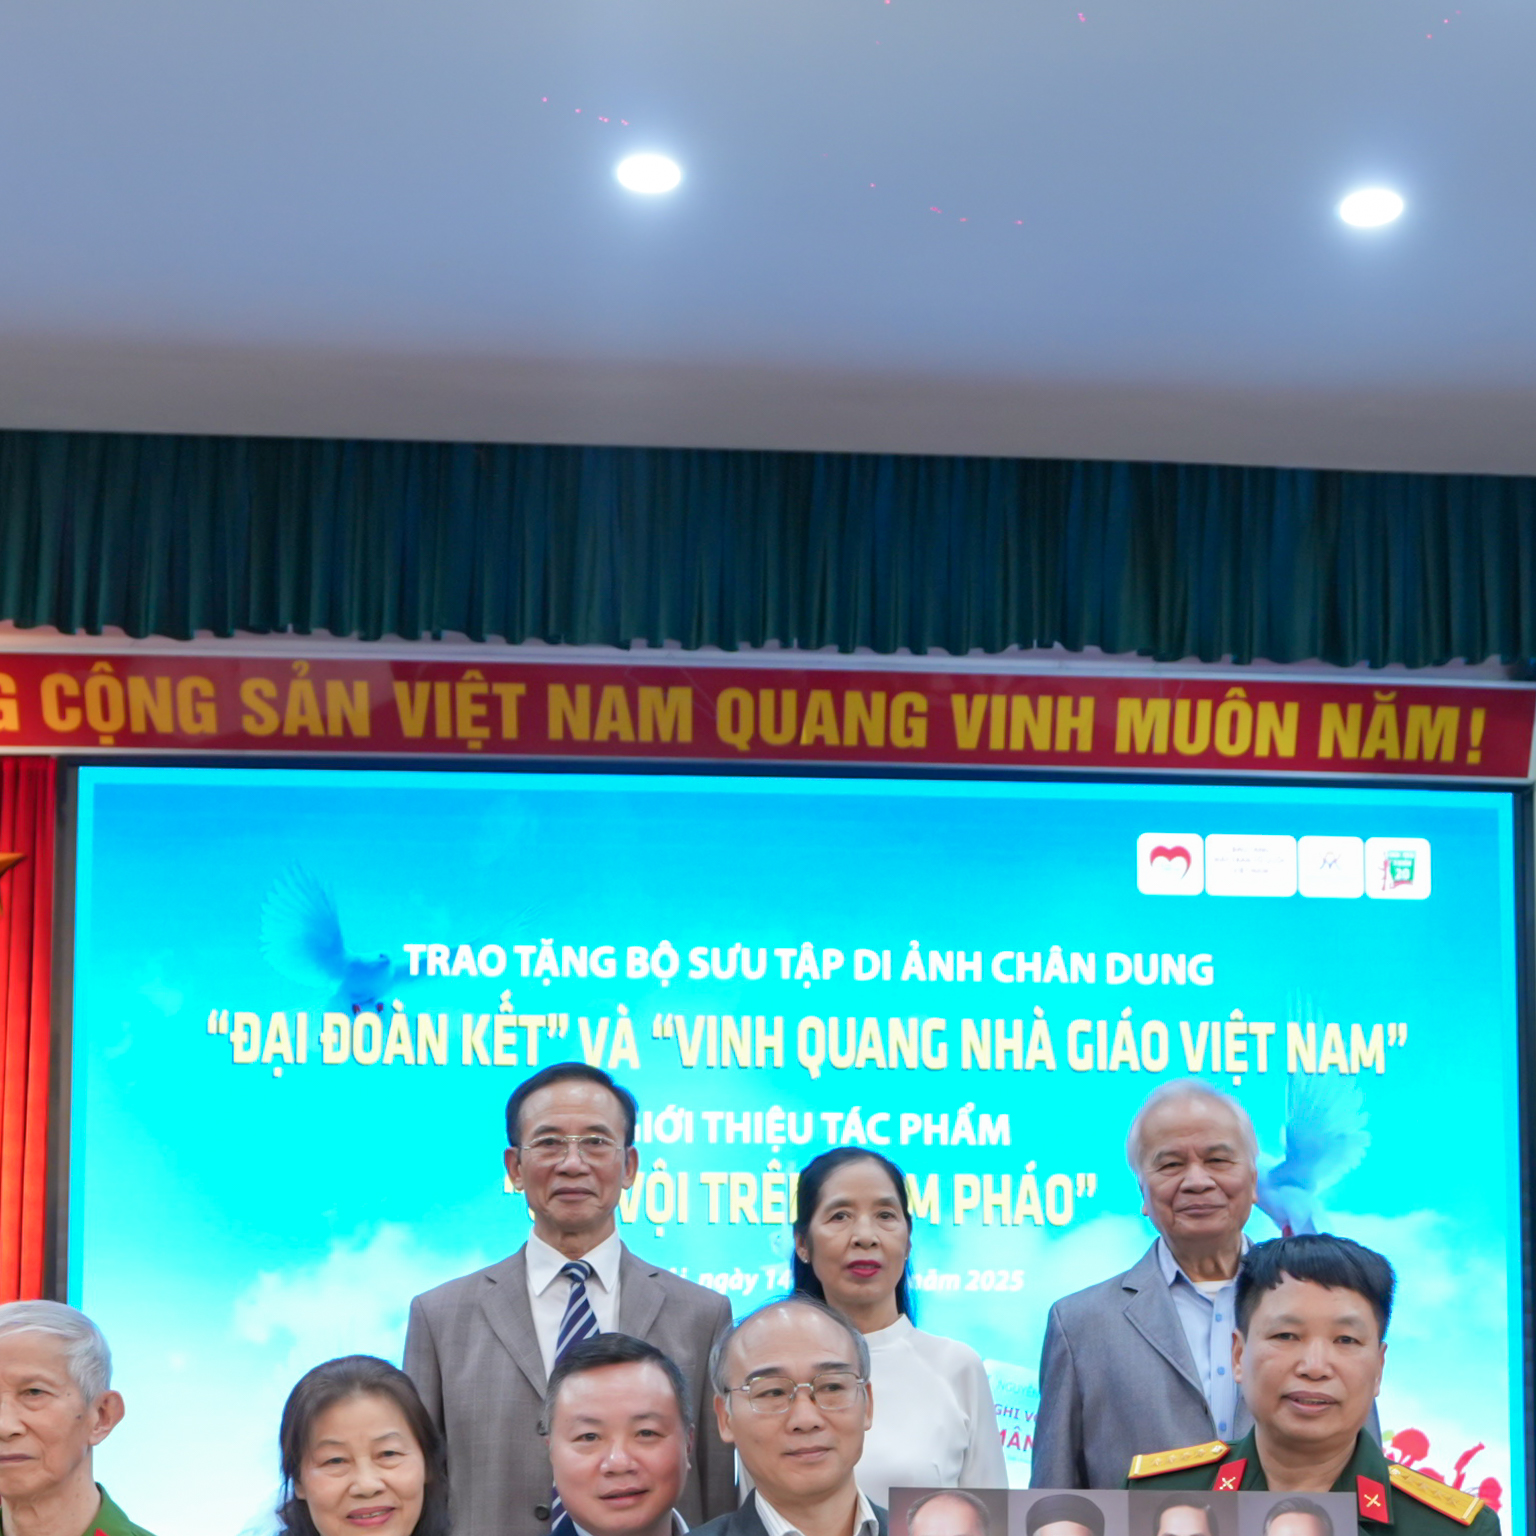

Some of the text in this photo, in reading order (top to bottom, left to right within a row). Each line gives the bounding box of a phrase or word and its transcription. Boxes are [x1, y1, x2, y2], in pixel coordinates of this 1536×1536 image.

[41, 661, 217, 746] CỘNG
[240, 659, 373, 738] SẢN
[393, 669, 527, 751] VIỆT
[547, 683, 694, 744] NAM
[715, 686, 929, 752] QUANG
[951, 693, 1094, 753] VINH
[1114, 687, 1299, 758] MUÔN
[1317, 690, 1486, 764] NĂM!
[403, 938, 1215, 989] TRAO TẶNG BỘ SƯU TẬP DI ẢNH CHÂN DUNG
[207, 989, 1408, 1086] “ĐẠI ĐOÀN KẾT” VÀ “VINH QUANG NHÀ GIÁO VIỆT NAM”
[634, 1101, 1011, 1153] IỚI THIỆU TÁC PHẨM
[953, 1160, 1097, 1227] PHÁO”
[698, 1267, 759, 1296] ngày
[766, 1268, 792, 1291] 14
[964, 1269, 1025, 1292] 2025
